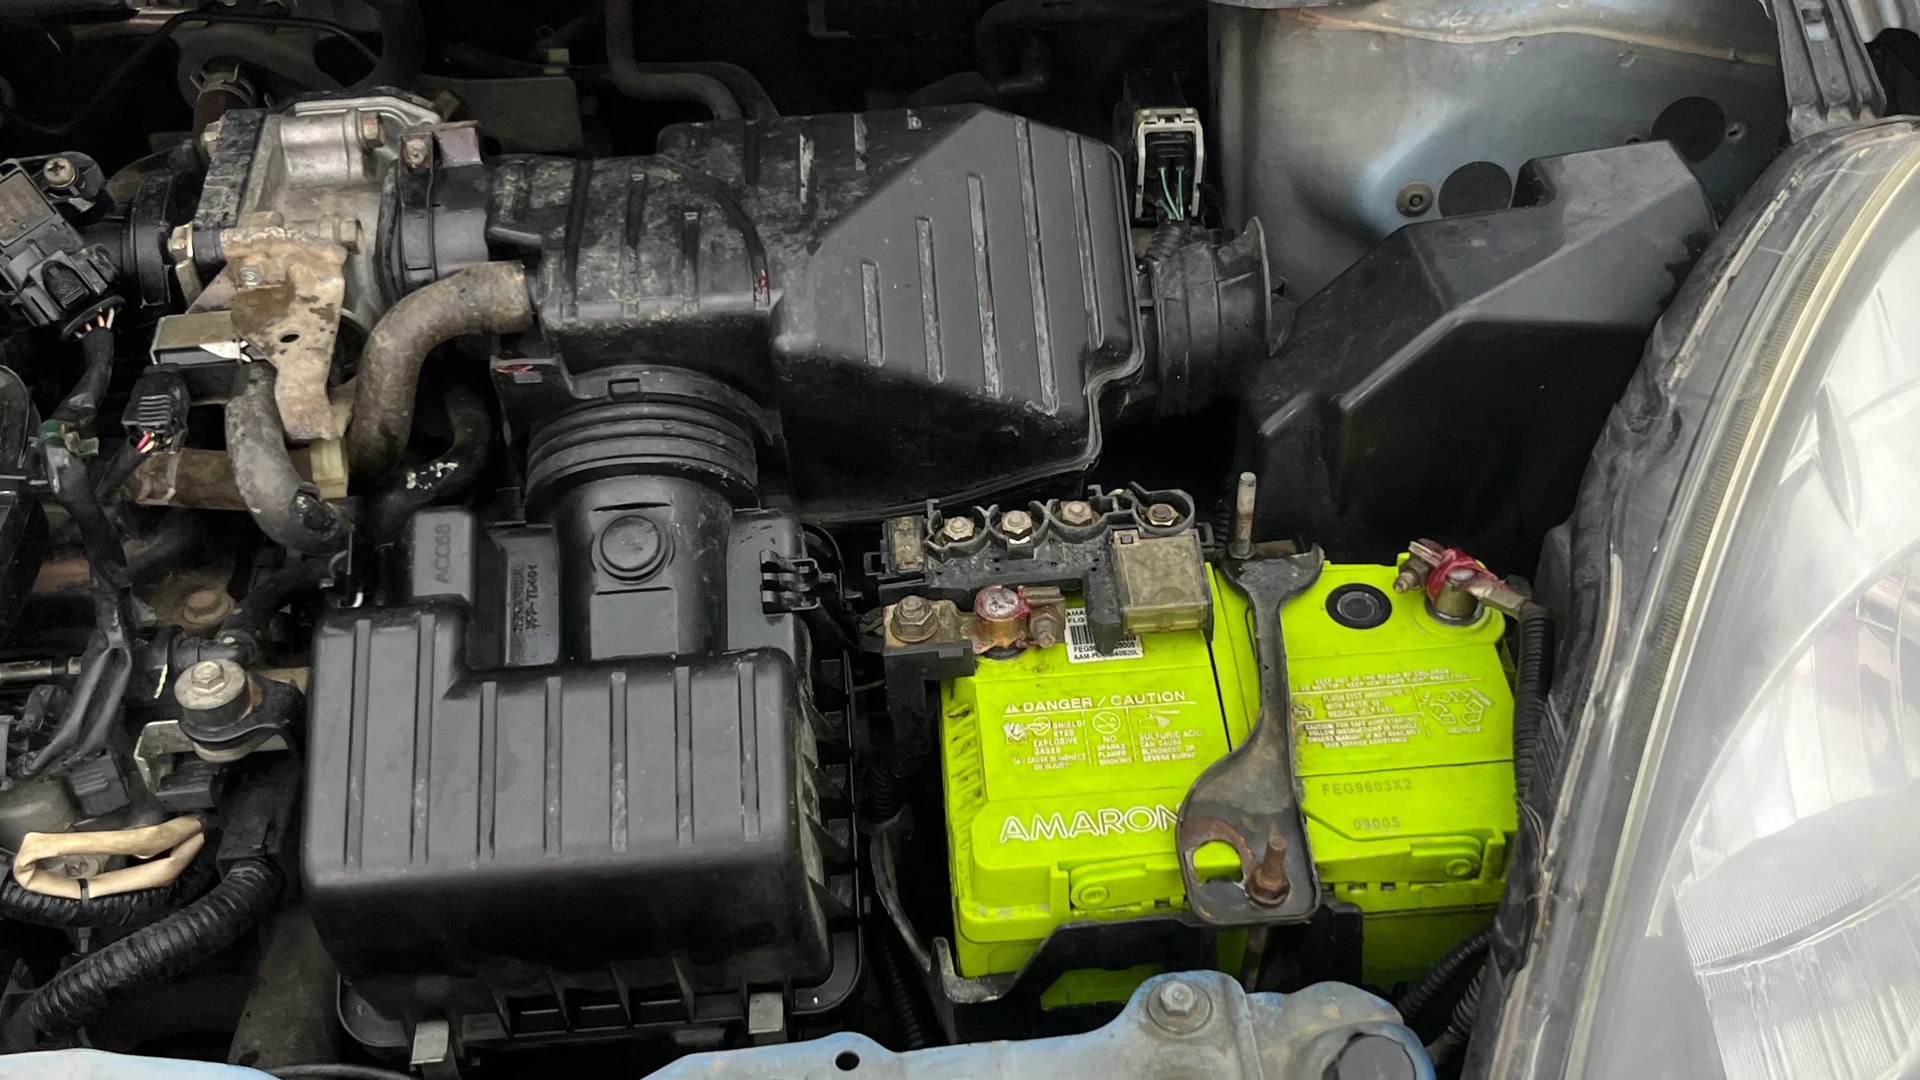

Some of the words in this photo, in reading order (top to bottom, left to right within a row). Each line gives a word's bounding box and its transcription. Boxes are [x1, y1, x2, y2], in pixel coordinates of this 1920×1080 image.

[1023, 697, 1093, 713] DANGER
[1110, 690, 1186, 706] CAUTION
[1054, 729, 1074, 738] EYES
[1139, 731, 1181, 741] SULFURIC
[1183, 729, 1202, 738] ACID
[1033, 736, 1078, 748] EXPLOSIVE
[1102, 735, 1117, 743] NO
[1140, 739, 1156, 748] CAN
[1158, 737, 1181, 746] CAUSE
[1097, 743, 1126, 752] SPARKS
[1185, 743, 1196, 752] OR
[1098, 750, 1127, 758] FLAMES
[1142, 752, 1171, 762] SEVERE
[1322, 778, 1413, 796] FEG9603X2
[1353, 816, 1401, 831] 09005
